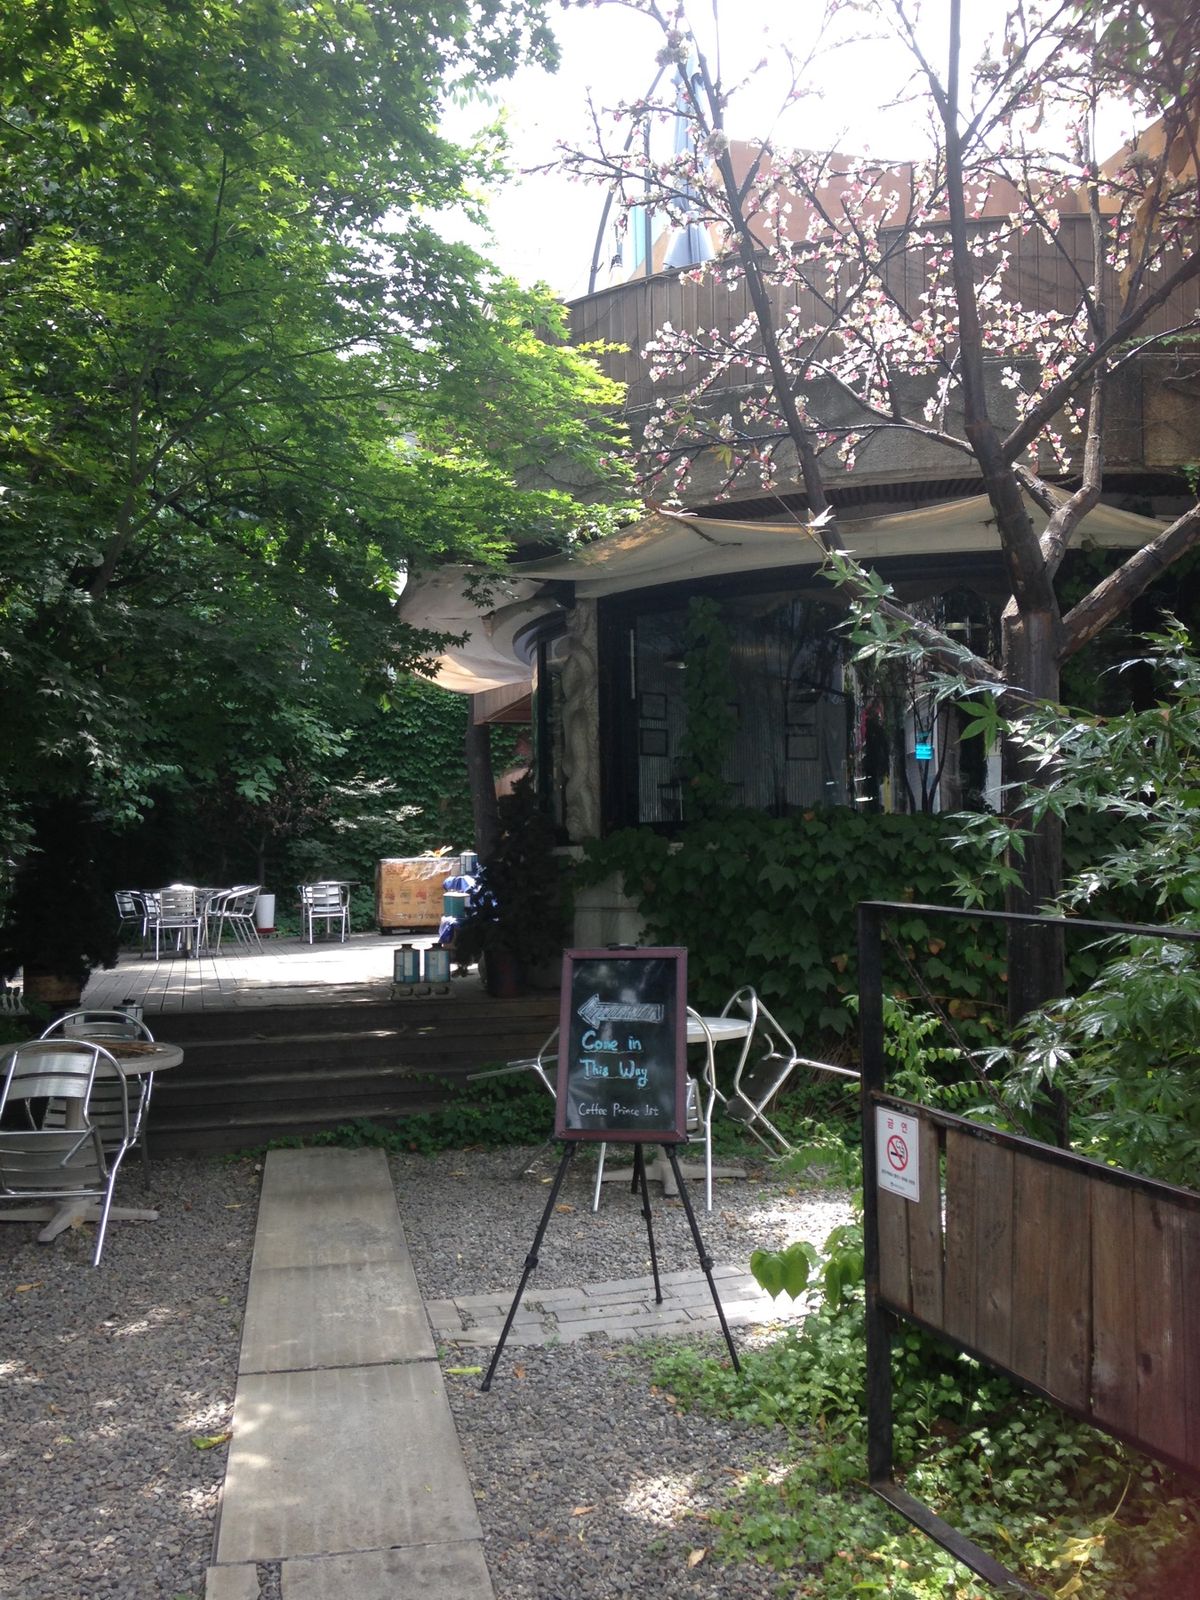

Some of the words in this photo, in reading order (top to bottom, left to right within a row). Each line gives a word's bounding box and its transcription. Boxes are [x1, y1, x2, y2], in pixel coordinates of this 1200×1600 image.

[581, 1030, 618, 1051] Come
[628, 1036, 642, 1050] in
[579, 1058, 609, 1077] This
[619, 1060, 648, 1087] Way
[578, 1102, 608, 1116] Coffee
[613, 1103, 640, 1117] Prince
[644, 1104, 659, 1116] 1st
